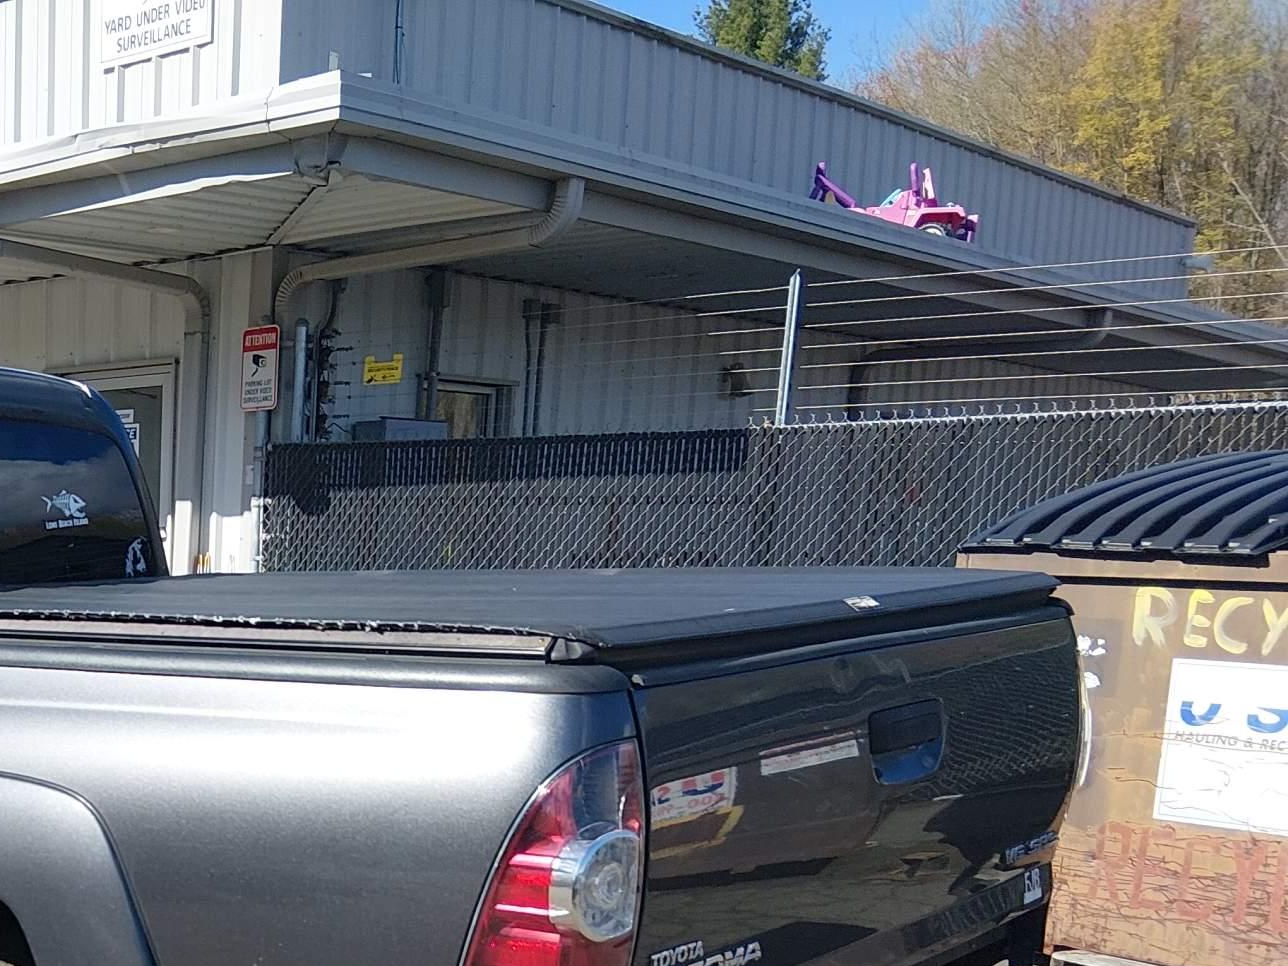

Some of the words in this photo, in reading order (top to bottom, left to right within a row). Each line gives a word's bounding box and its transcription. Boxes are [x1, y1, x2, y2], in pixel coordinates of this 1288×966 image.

[104, 15, 132, 35] YARD
[136, 3, 170, 27] UNDER
[116, 18, 191, 53] SURVEILLANCE
[244, 332, 277, 347] ATTENTION
[1174, 730, 1239, 748] HAULING
